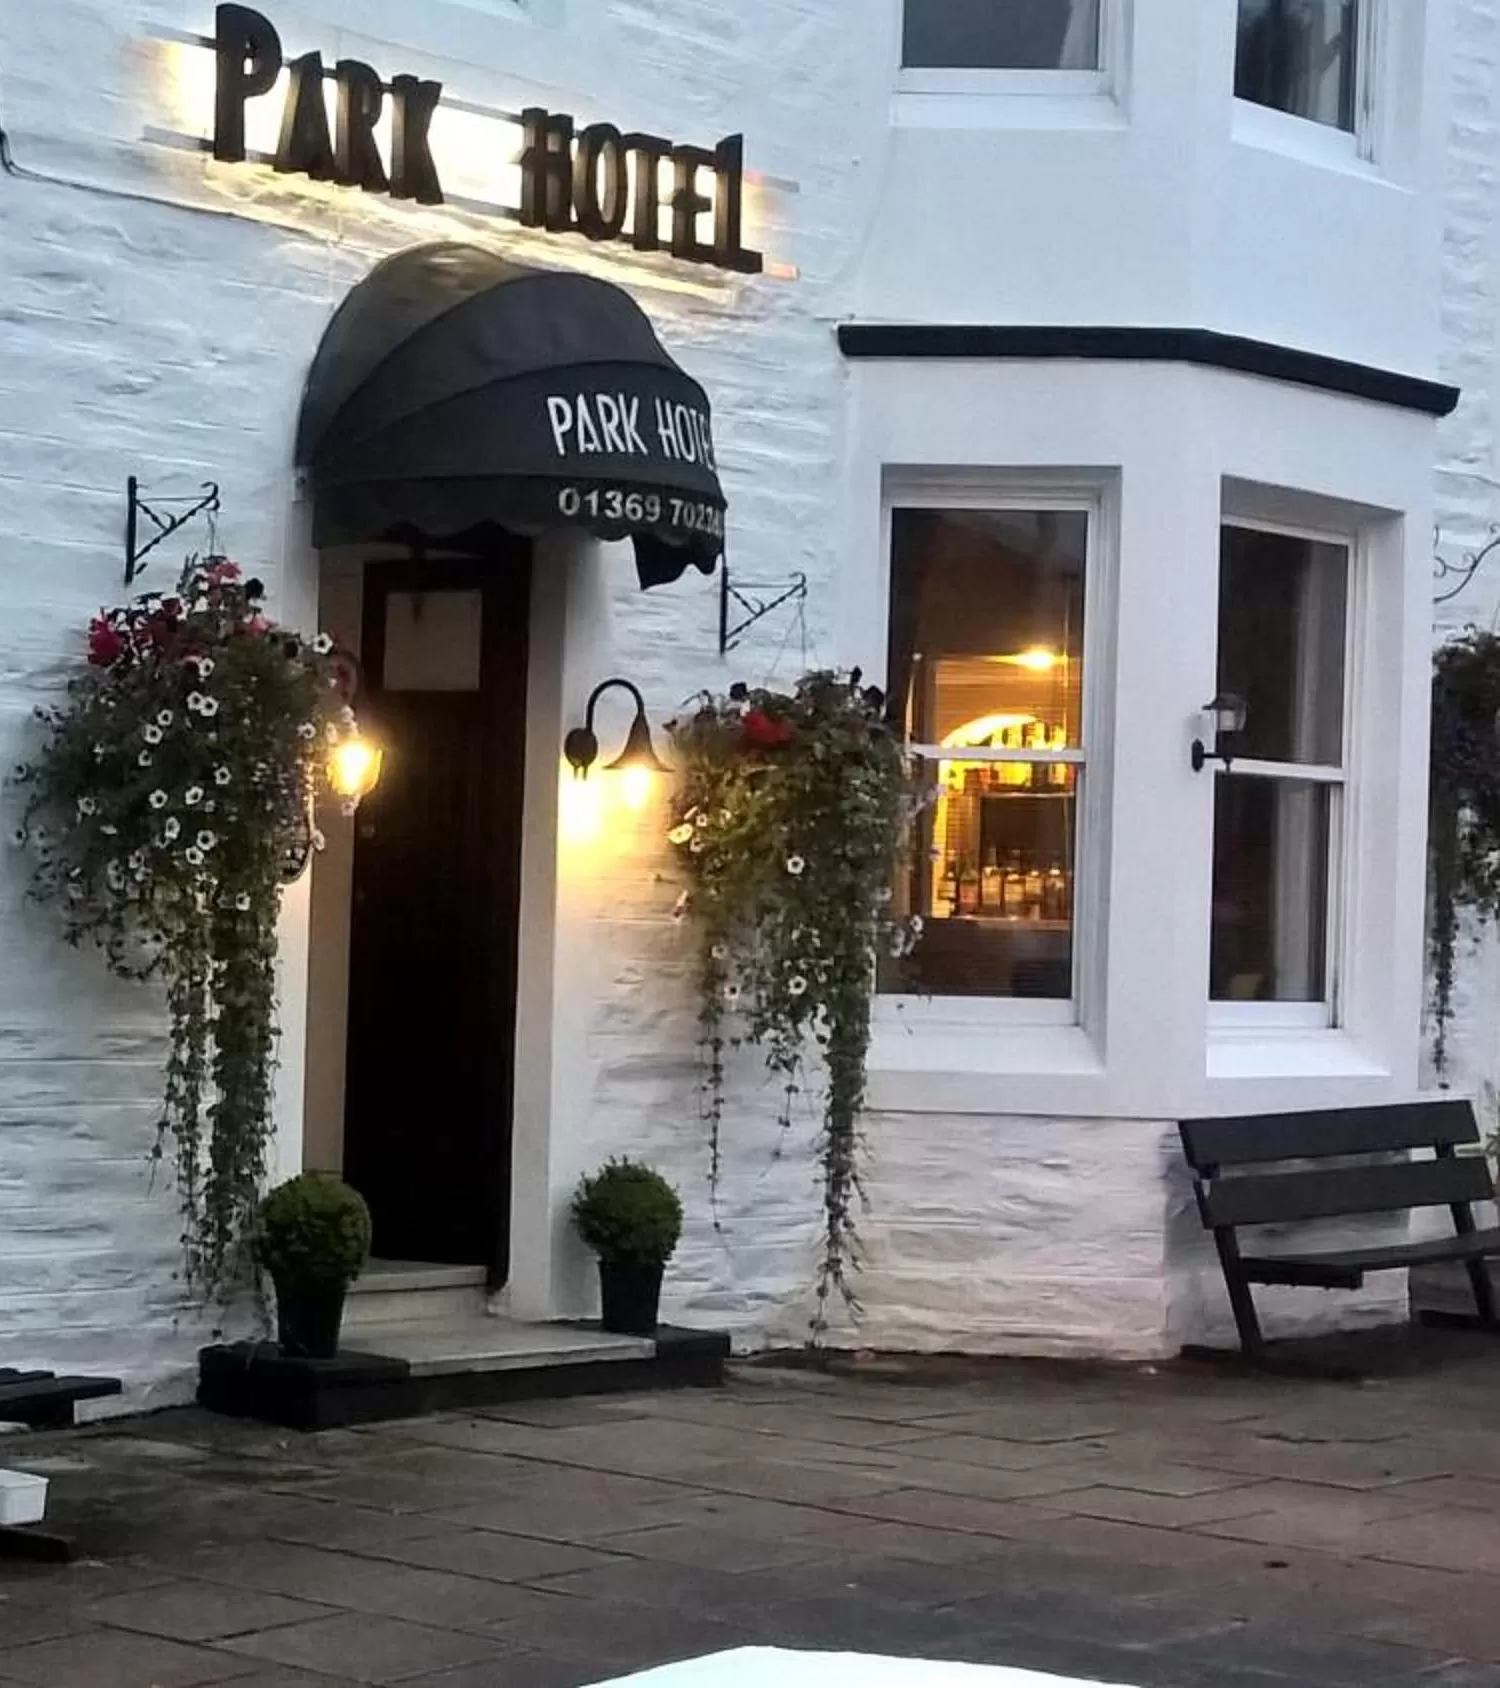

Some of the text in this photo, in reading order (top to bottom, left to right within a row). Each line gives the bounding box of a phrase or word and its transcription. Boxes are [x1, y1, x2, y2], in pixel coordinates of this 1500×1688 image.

[214, 3, 762, 273] PARK HOTEL
[547, 393, 714, 471] PARK HOTE
[558, 487, 661, 522] 01369
